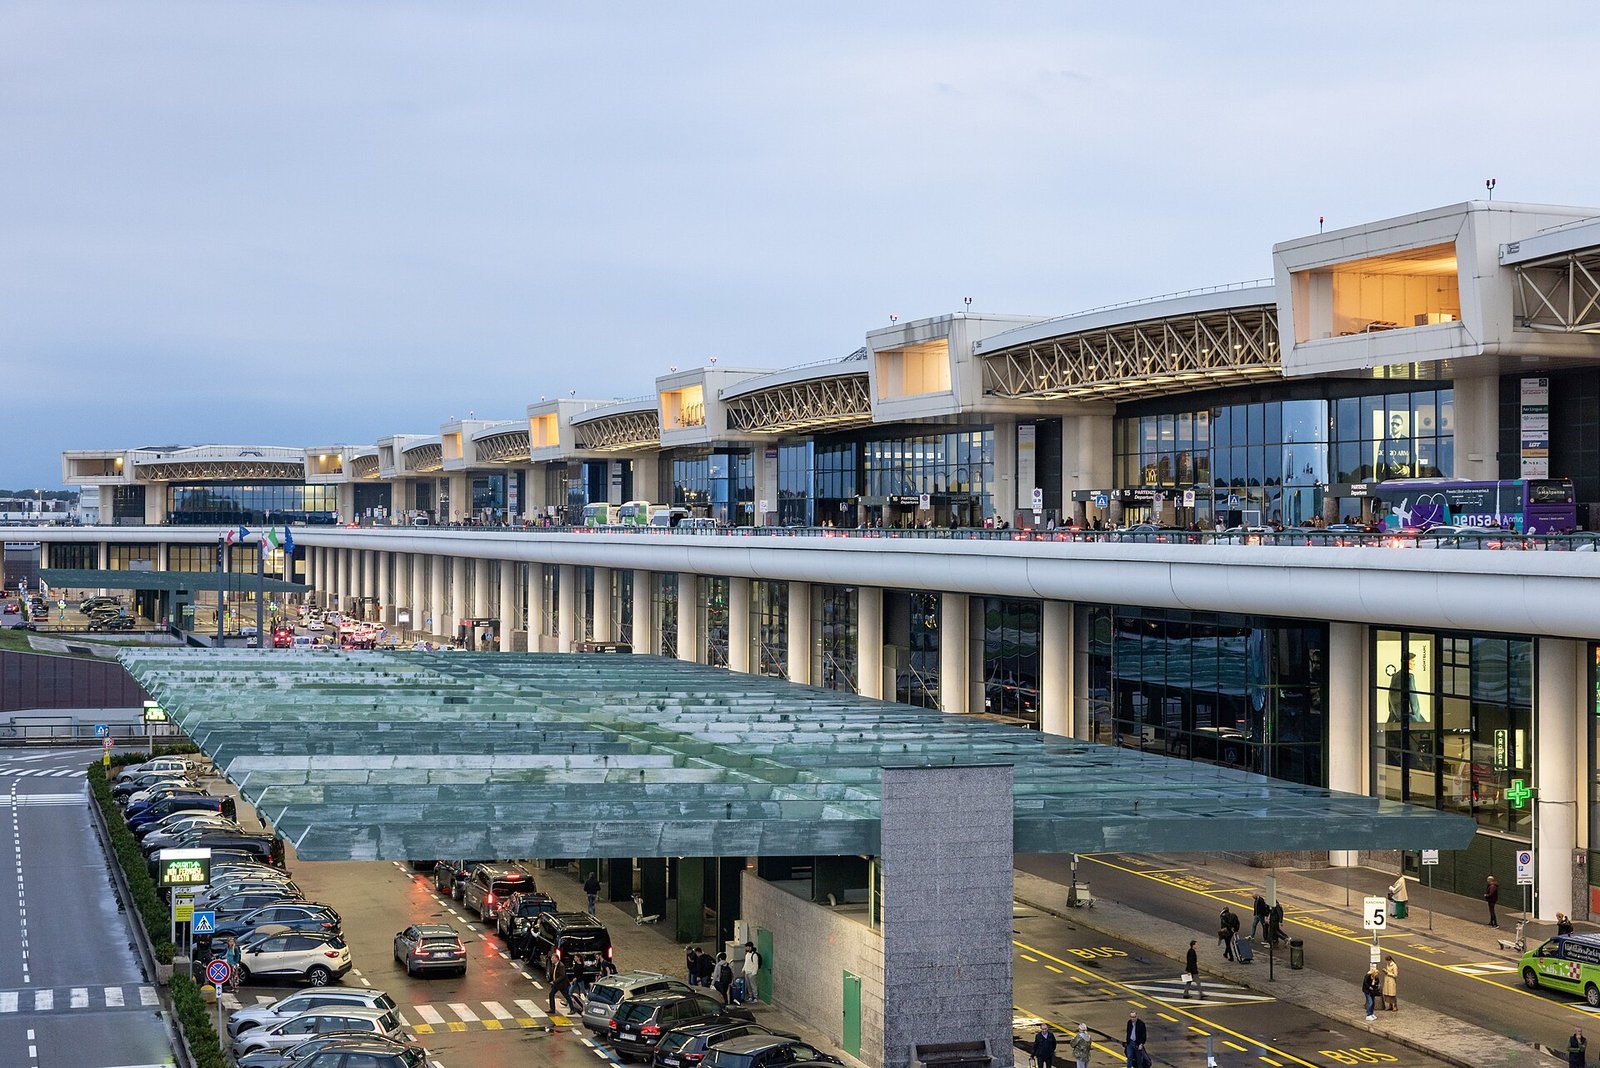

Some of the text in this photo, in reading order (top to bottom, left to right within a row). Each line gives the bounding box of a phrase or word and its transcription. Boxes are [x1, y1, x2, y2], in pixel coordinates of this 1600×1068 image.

[1373, 908, 1385, 926] 5
[1066, 946, 1129, 959] BUS
[1317, 1047, 1399, 1065] BUS
